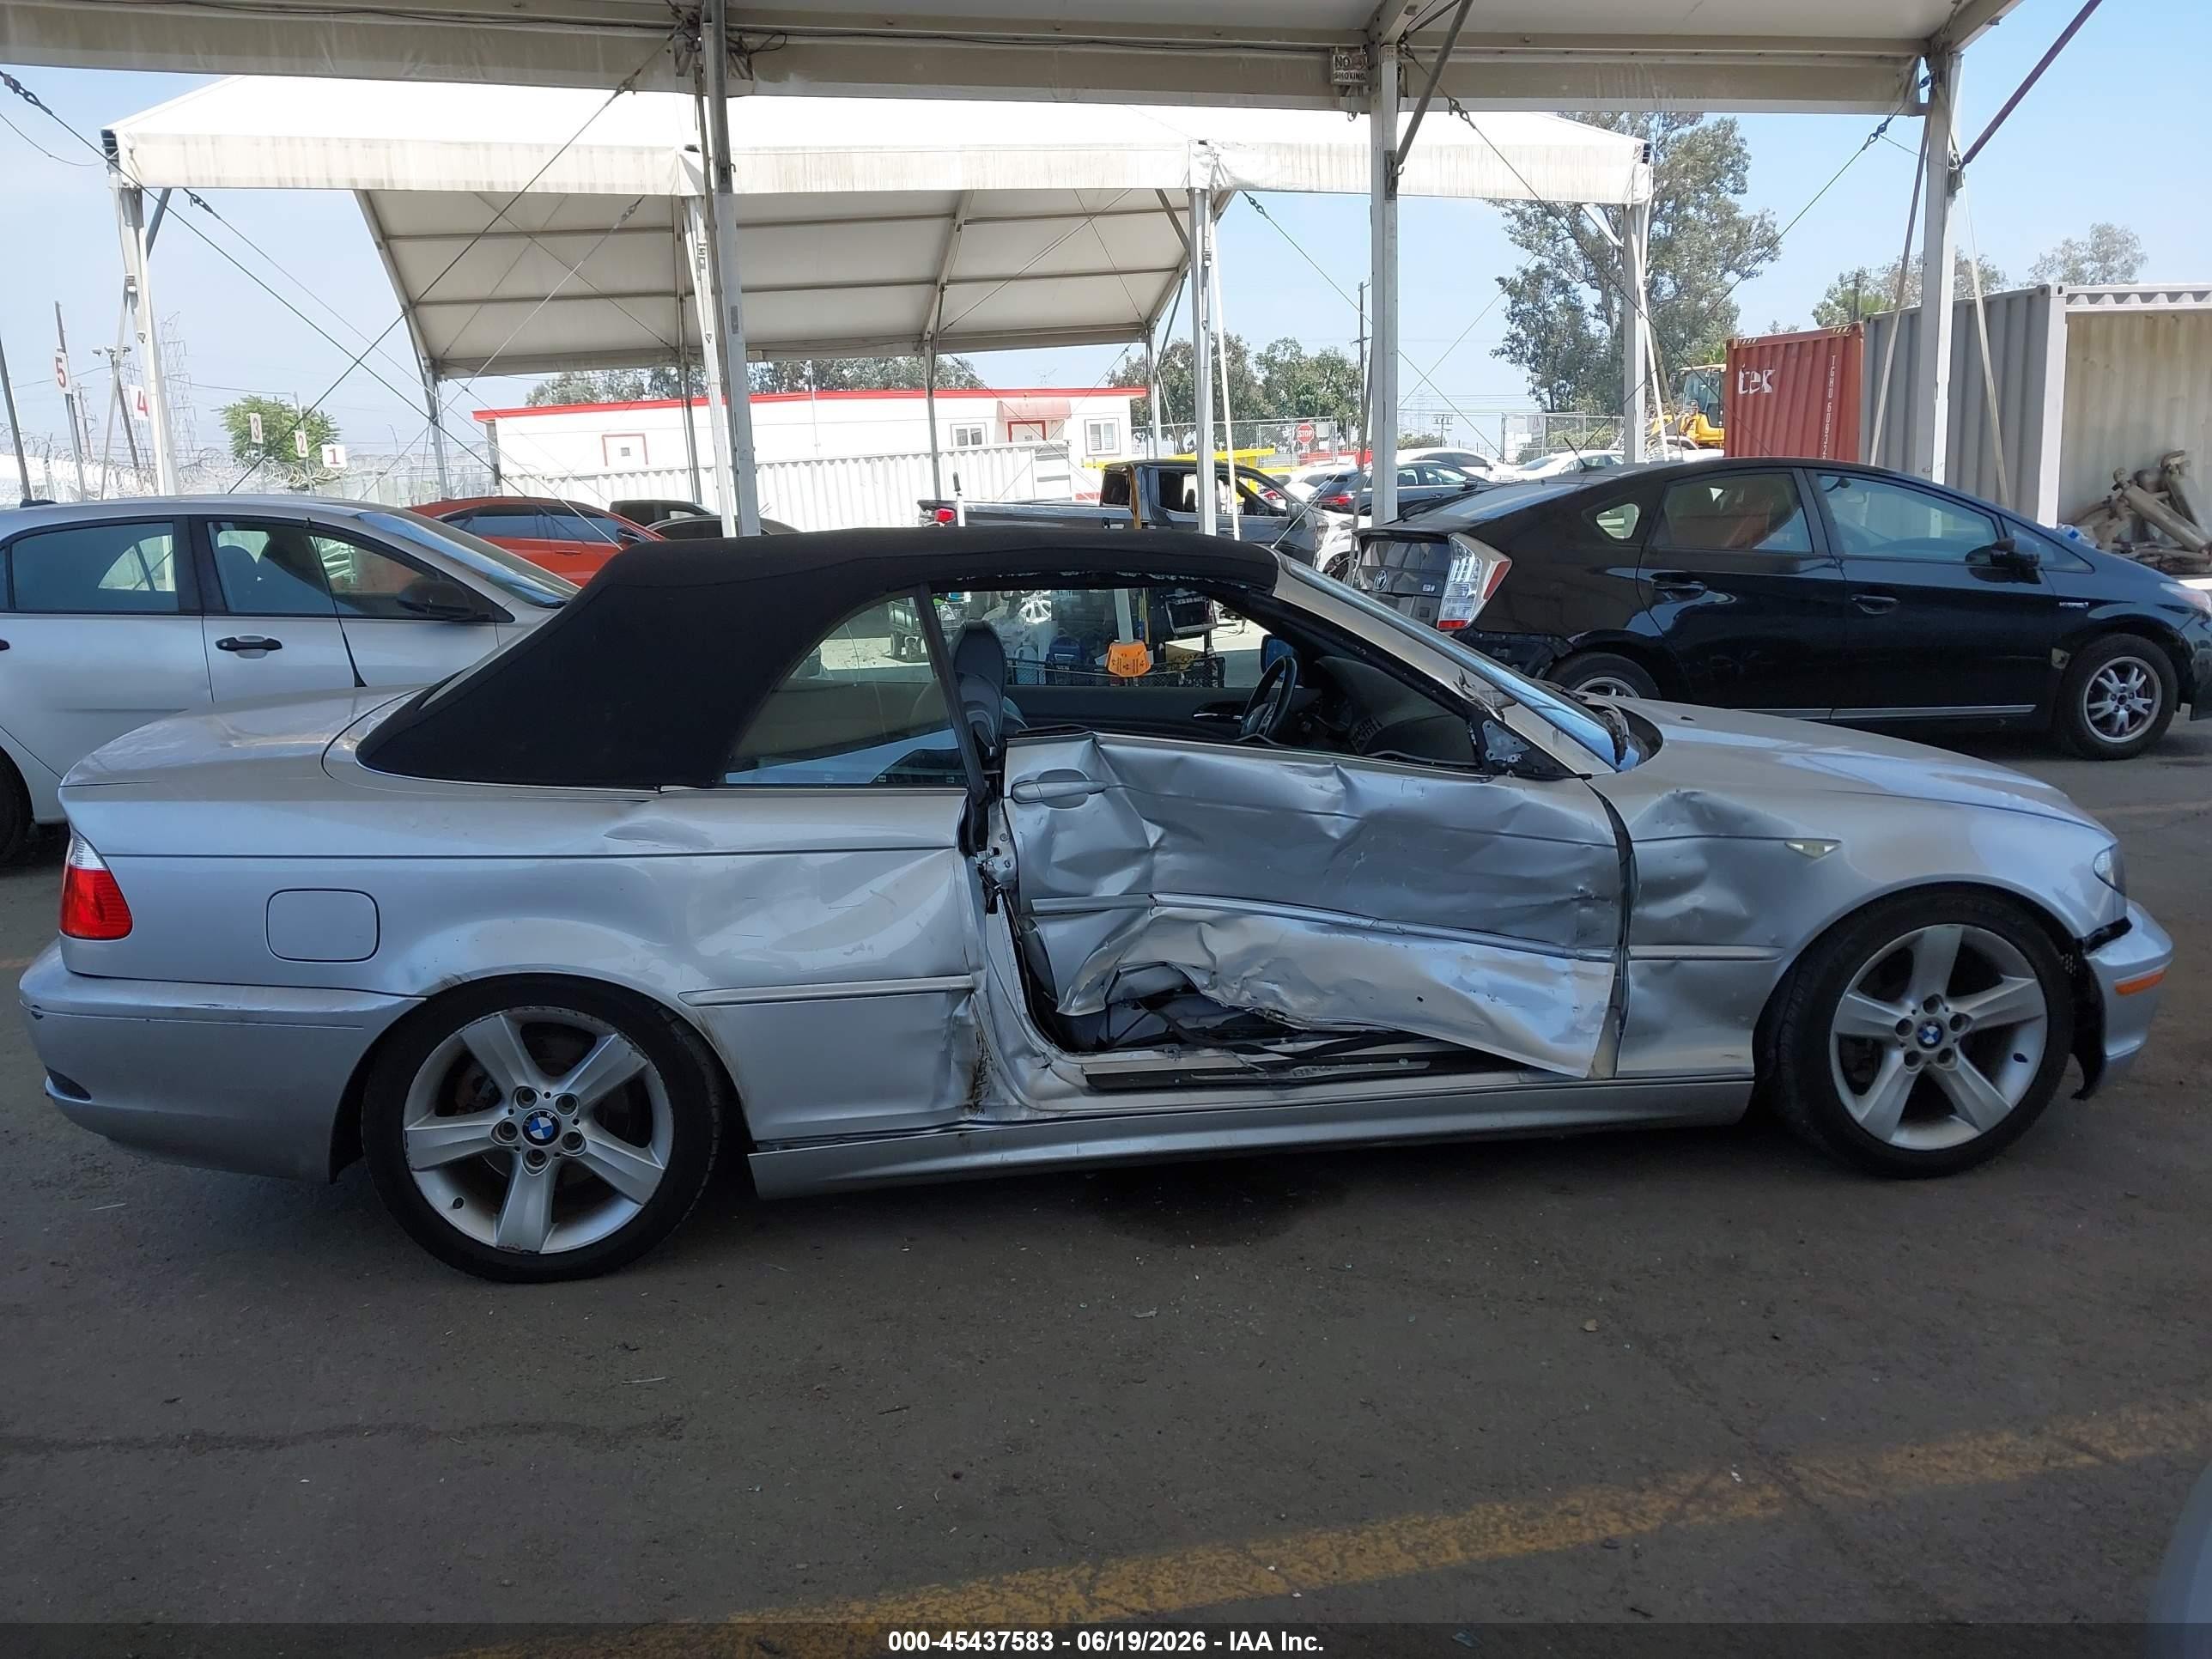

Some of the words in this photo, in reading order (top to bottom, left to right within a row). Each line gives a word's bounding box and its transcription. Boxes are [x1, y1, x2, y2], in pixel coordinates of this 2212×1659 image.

[1334, 56, 1351, 70] NO
[55, 356, 67, 389] 5
[137, 391, 149, 417] 4
[252, 416, 261, 440] 3
[1297, 429, 1313, 438] STOP
[297, 434, 306, 454] 2
[328, 447, 341, 465] 1
